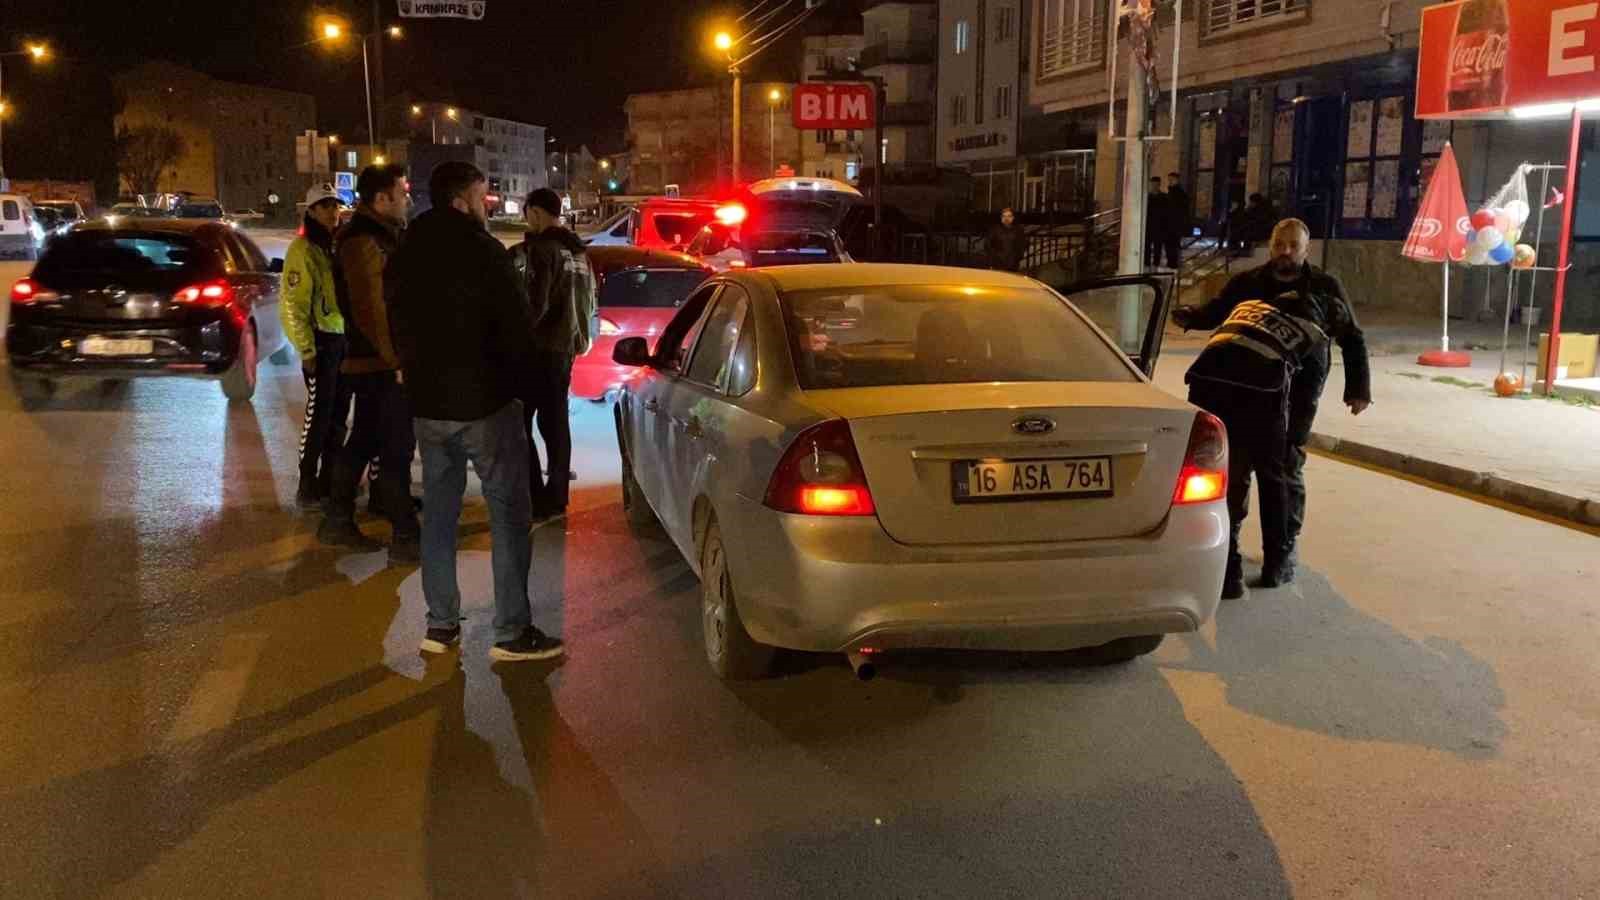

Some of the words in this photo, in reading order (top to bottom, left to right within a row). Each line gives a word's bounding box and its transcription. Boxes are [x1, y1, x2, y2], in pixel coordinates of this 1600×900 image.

[800, 86, 867, 120] BİM
[973, 467, 997, 493] 16
[1012, 464, 1051, 492] ASA
[1064, 461, 1104, 489] 764
